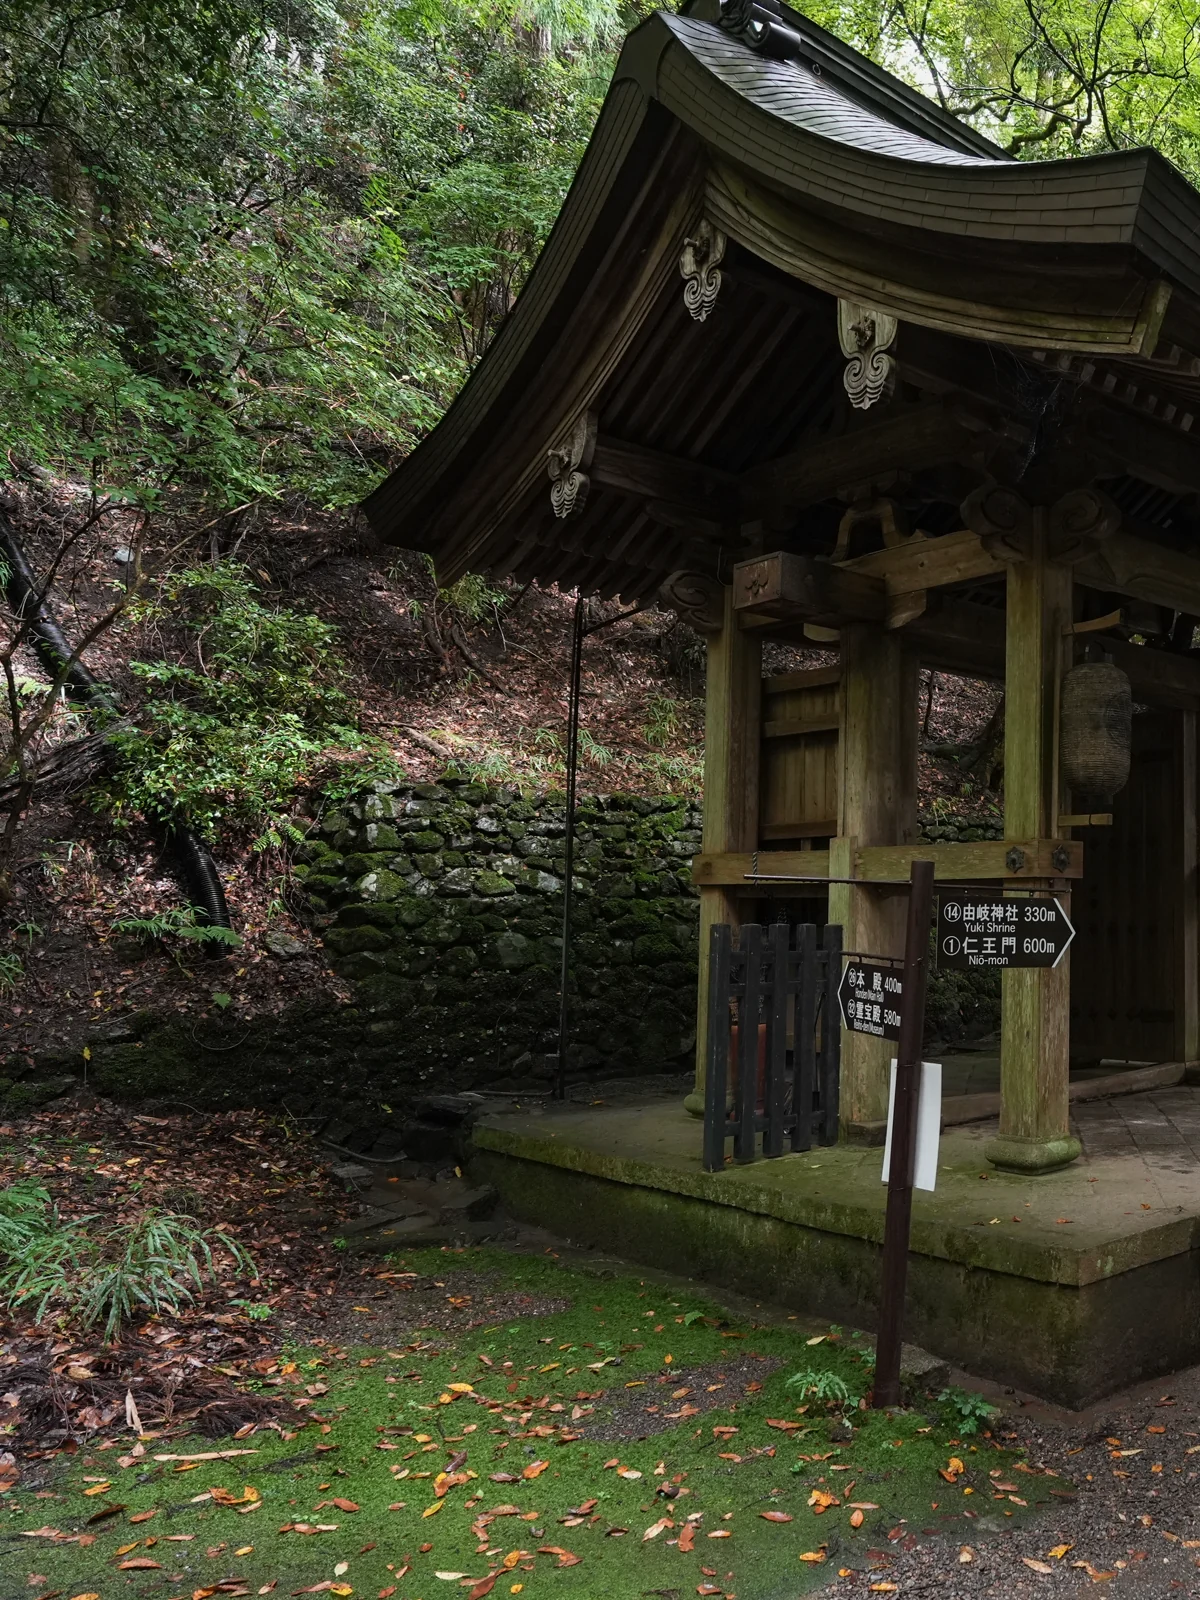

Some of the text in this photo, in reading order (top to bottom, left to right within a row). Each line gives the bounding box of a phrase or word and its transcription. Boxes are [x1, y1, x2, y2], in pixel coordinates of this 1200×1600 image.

[1024, 907, 1056, 922] 330m
[964, 922, 1016, 933] Yuki Shrine
[1023, 938, 1055, 954] 600m
[968, 955, 1009, 965] Niō-mon
[884, 977, 902, 994] 400m
[883, 1009, 901, 1027] 580m
